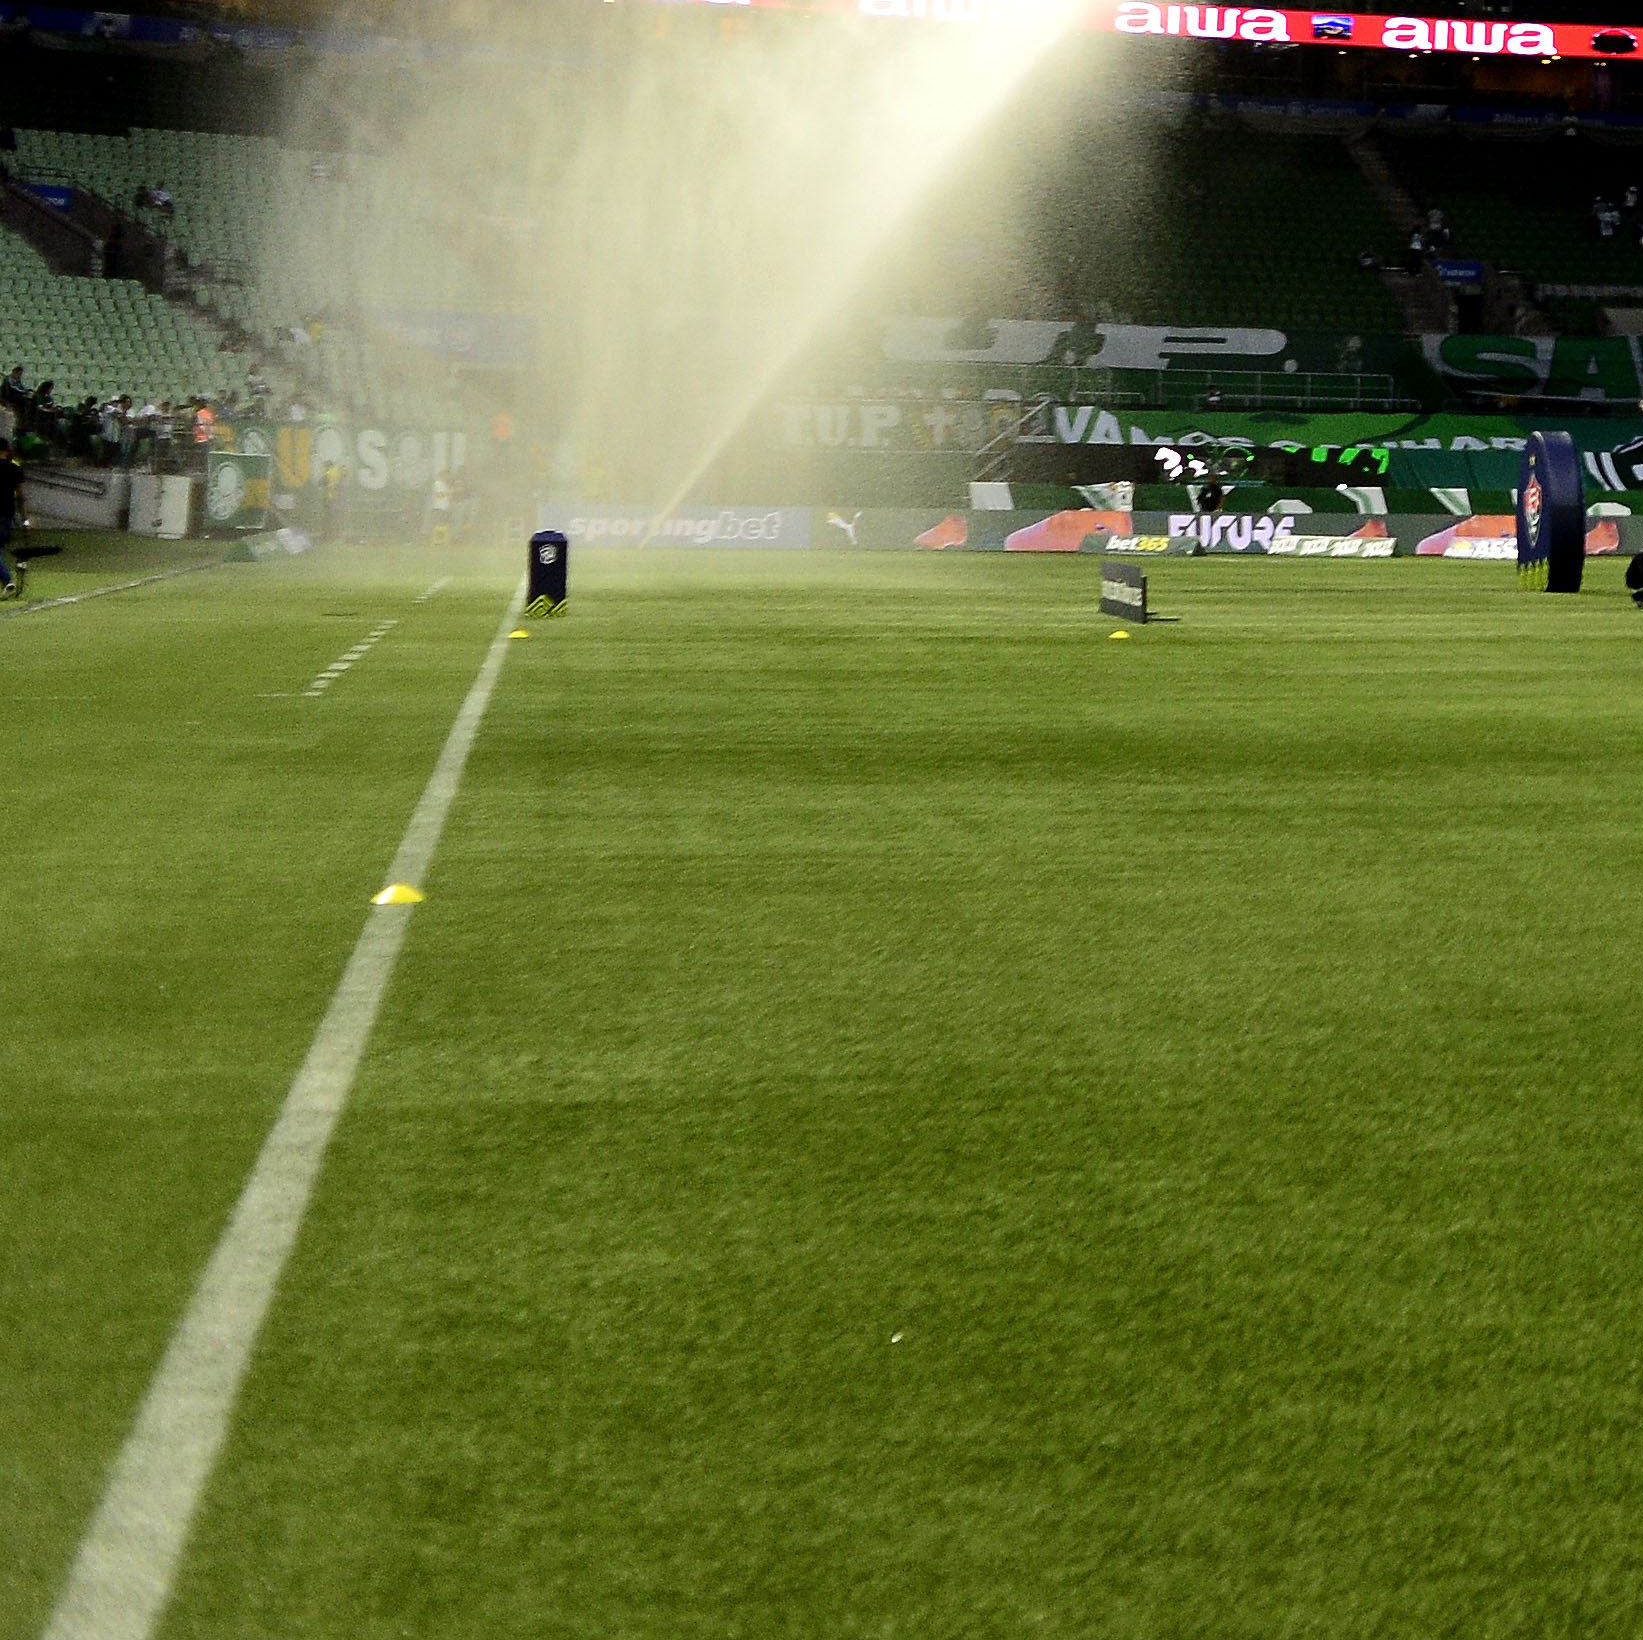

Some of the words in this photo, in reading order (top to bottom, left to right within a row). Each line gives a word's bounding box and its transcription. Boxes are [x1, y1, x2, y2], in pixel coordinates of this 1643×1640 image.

[1116, 2, 1289, 43] aiwa
[1382, 16, 1556, 58] aiwa
[568, 511, 784, 543] sportingbet
[1105, 535, 1170, 551] bet365
[1168, 514, 1295, 550] FUTURE
